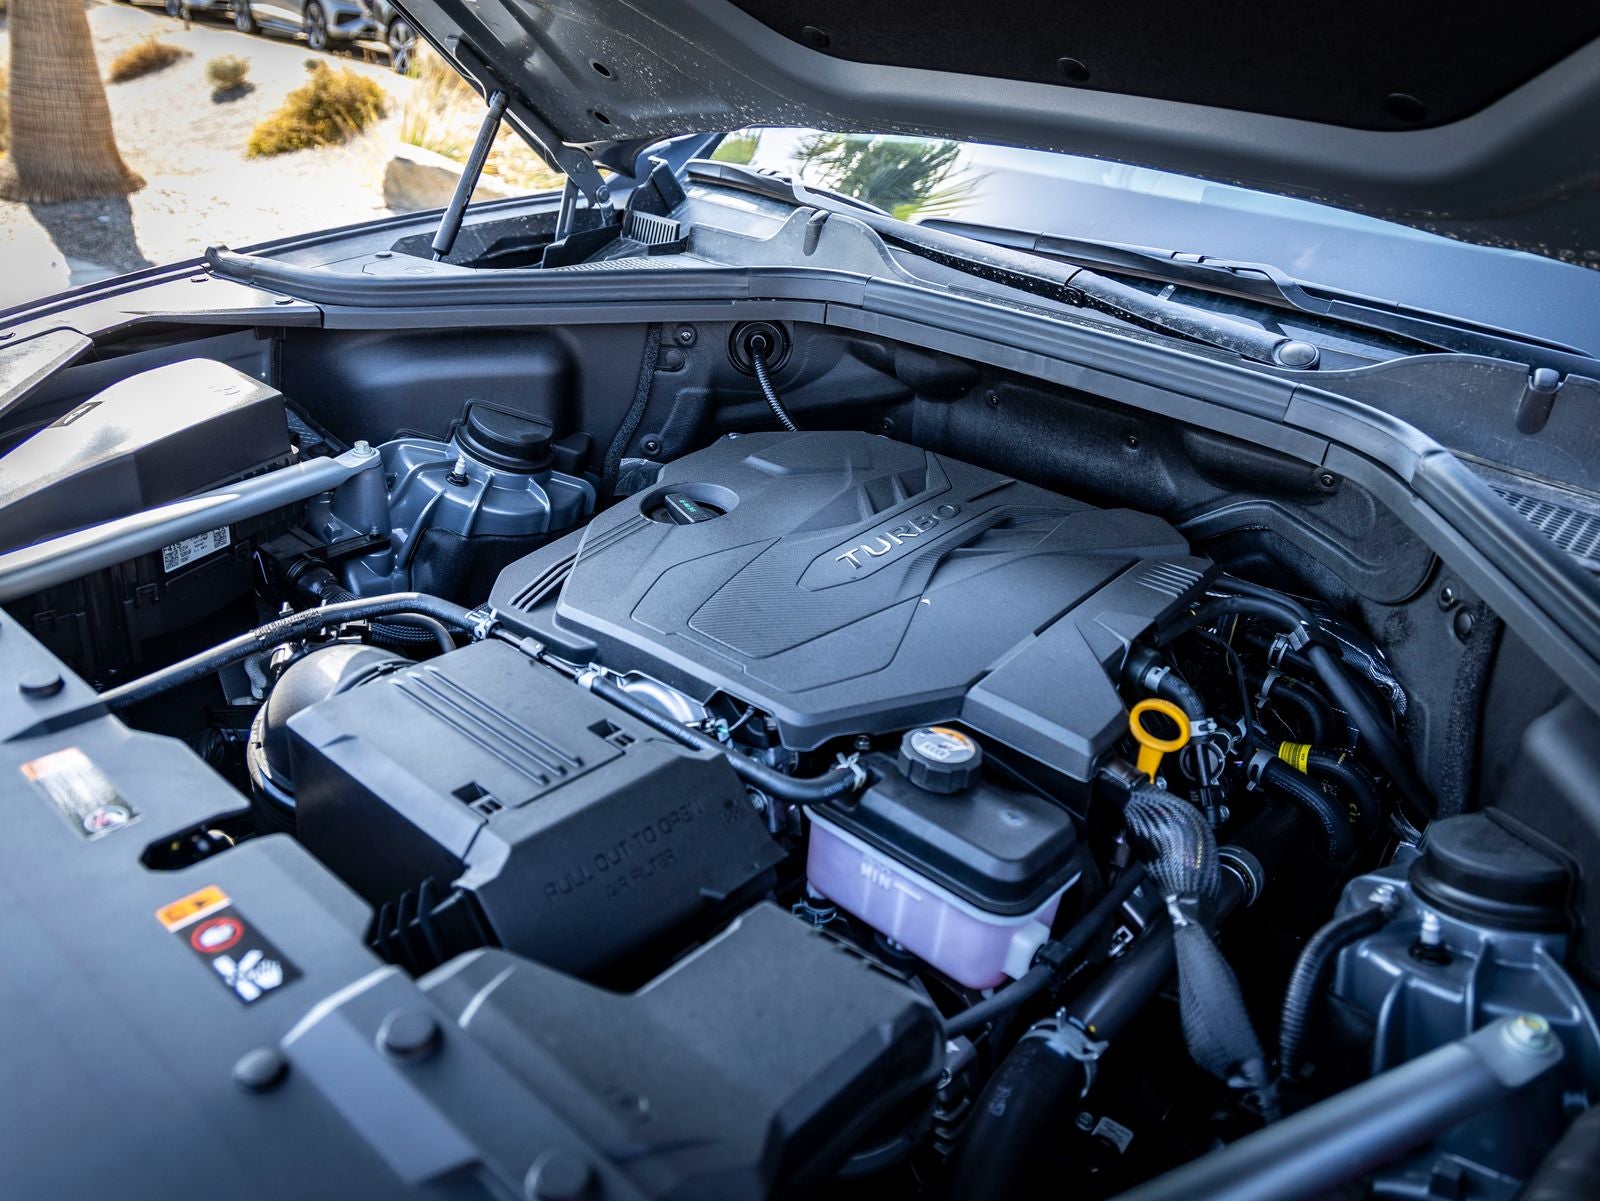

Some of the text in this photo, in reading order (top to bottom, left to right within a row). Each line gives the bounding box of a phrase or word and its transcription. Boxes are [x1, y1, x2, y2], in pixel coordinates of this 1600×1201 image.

[834, 502, 962, 570] TURBO
[543, 865, 595, 902] PULL
[593, 839, 629, 872] OUT
[633, 825, 657, 847] TO
[859, 861, 891, 891] MIN
